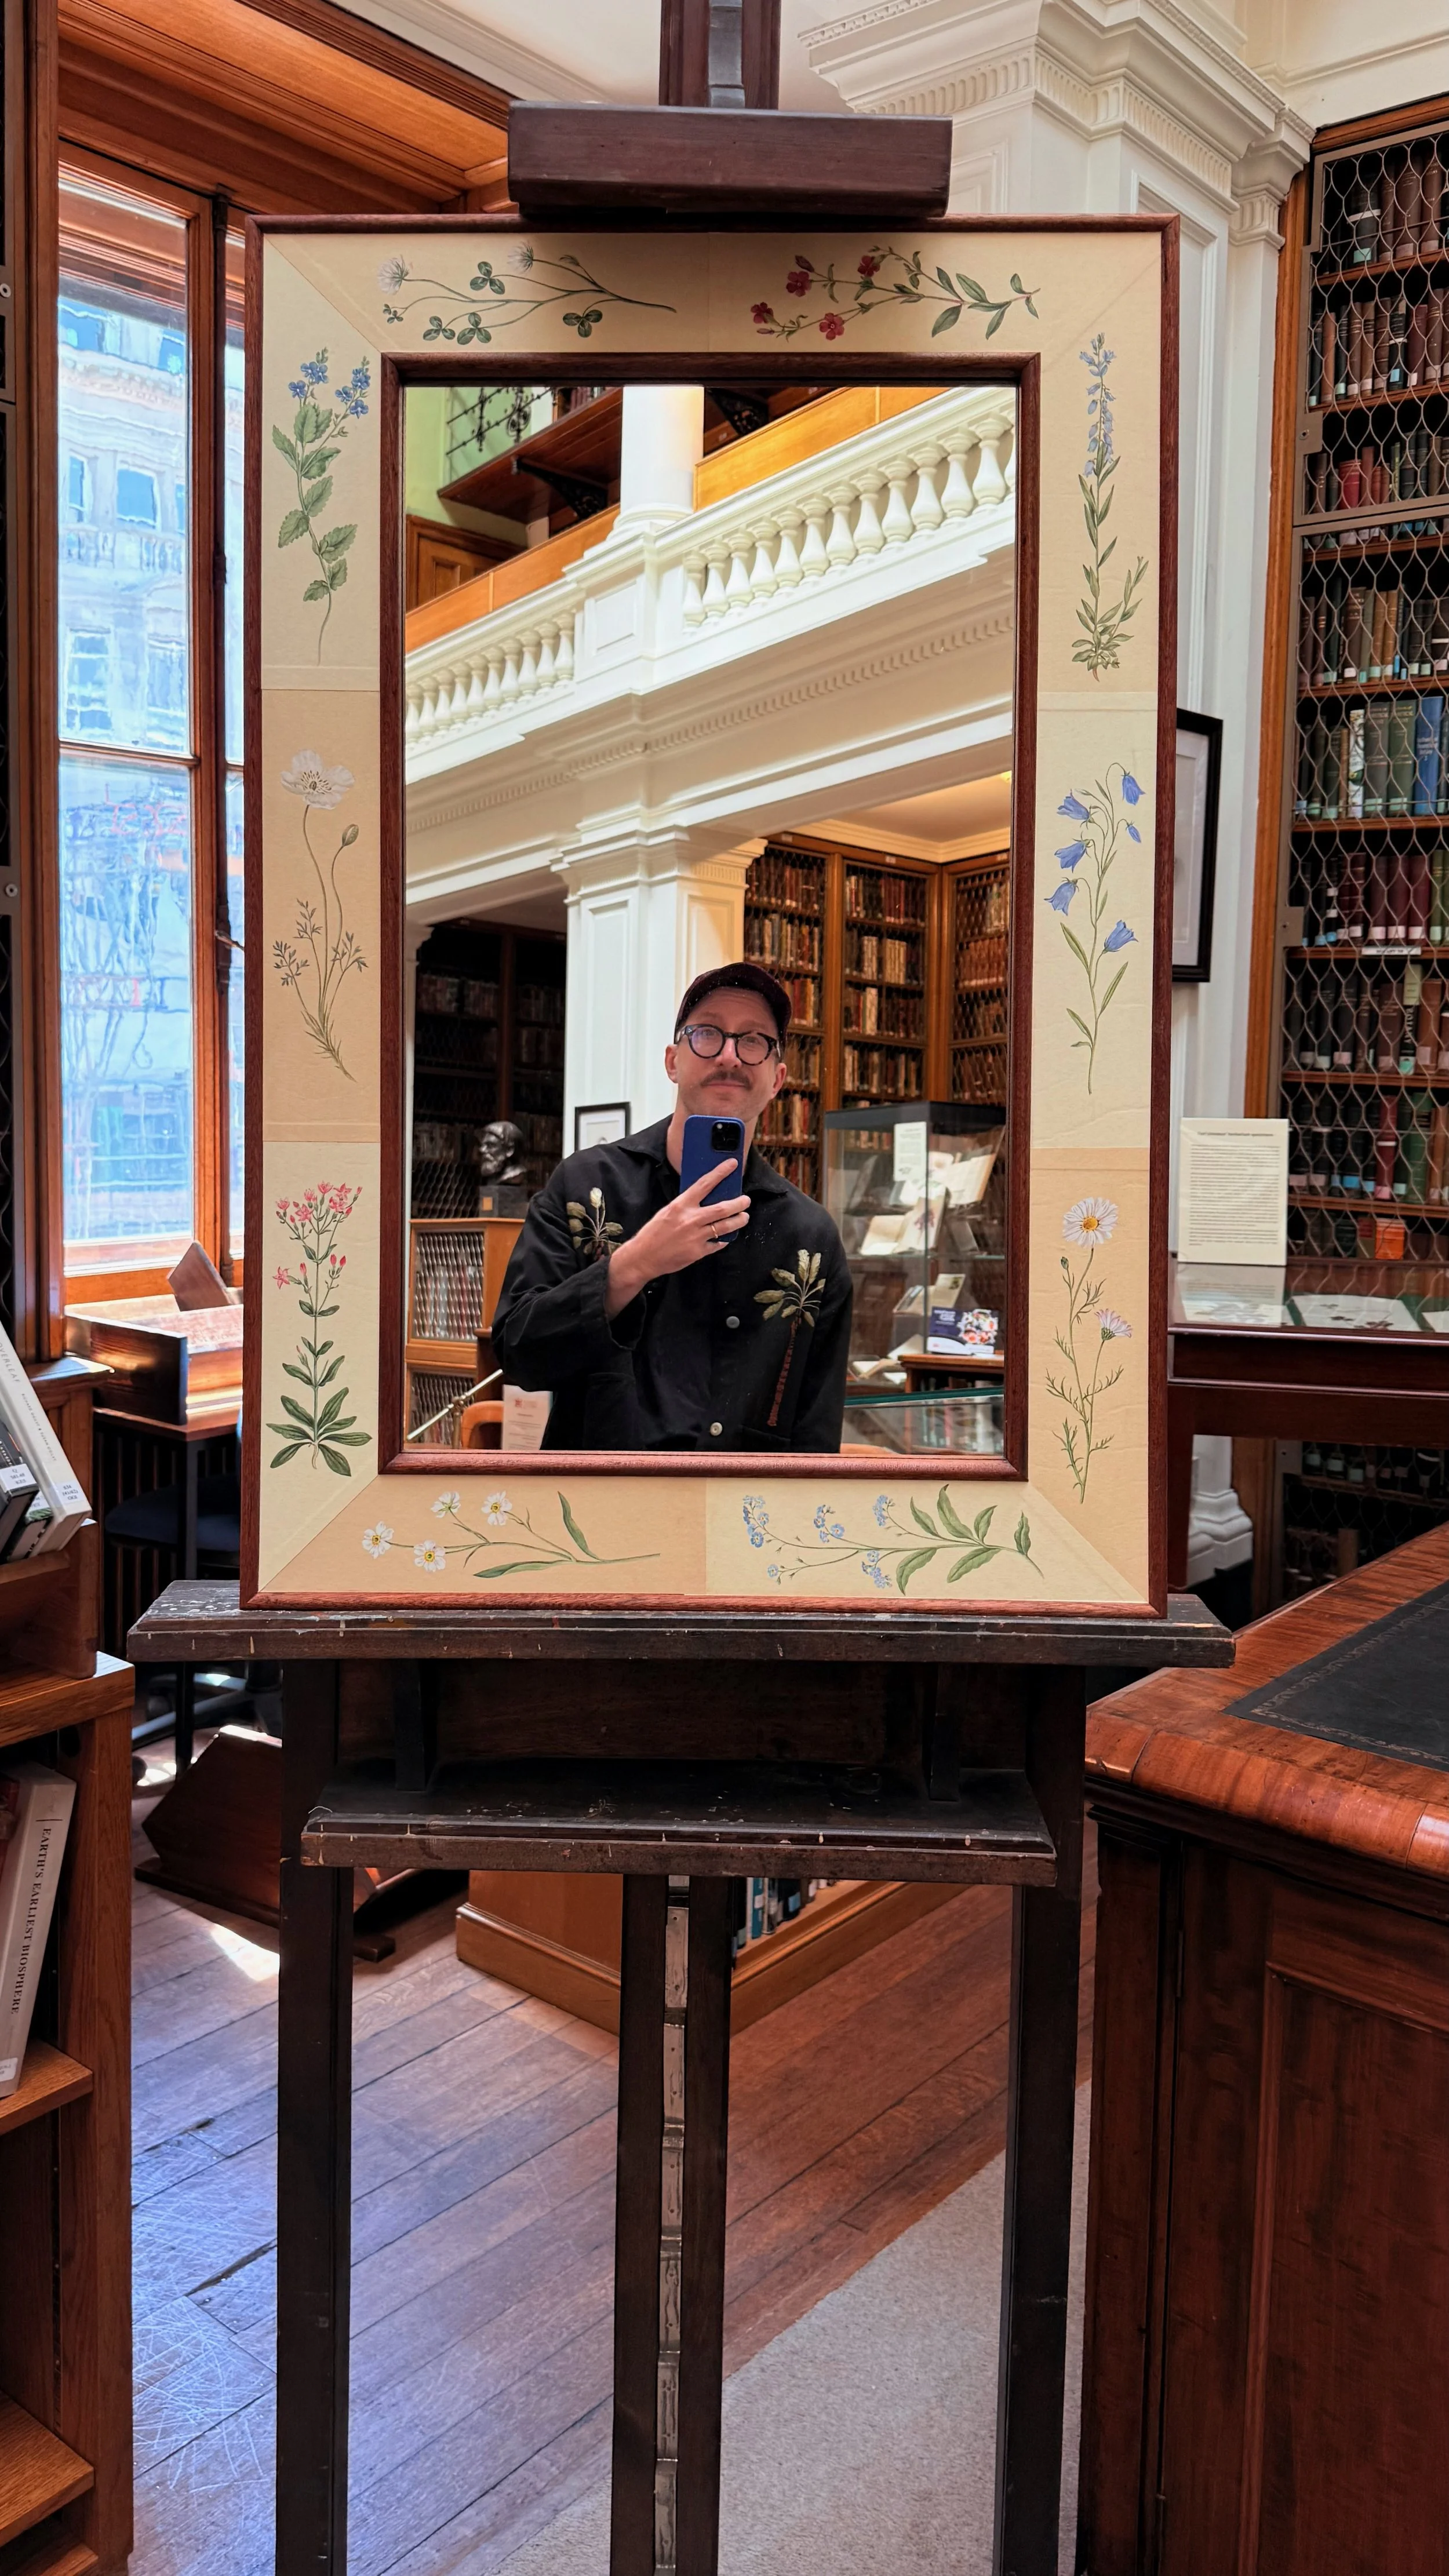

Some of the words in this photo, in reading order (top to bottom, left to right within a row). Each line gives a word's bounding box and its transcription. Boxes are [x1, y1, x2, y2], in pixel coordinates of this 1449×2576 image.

[35, 1828, 51, 1878] EARTH'S
[24, 1883, 42, 1941] EARLIEST
[11, 1945, 30, 2015] BIOSPHERE
